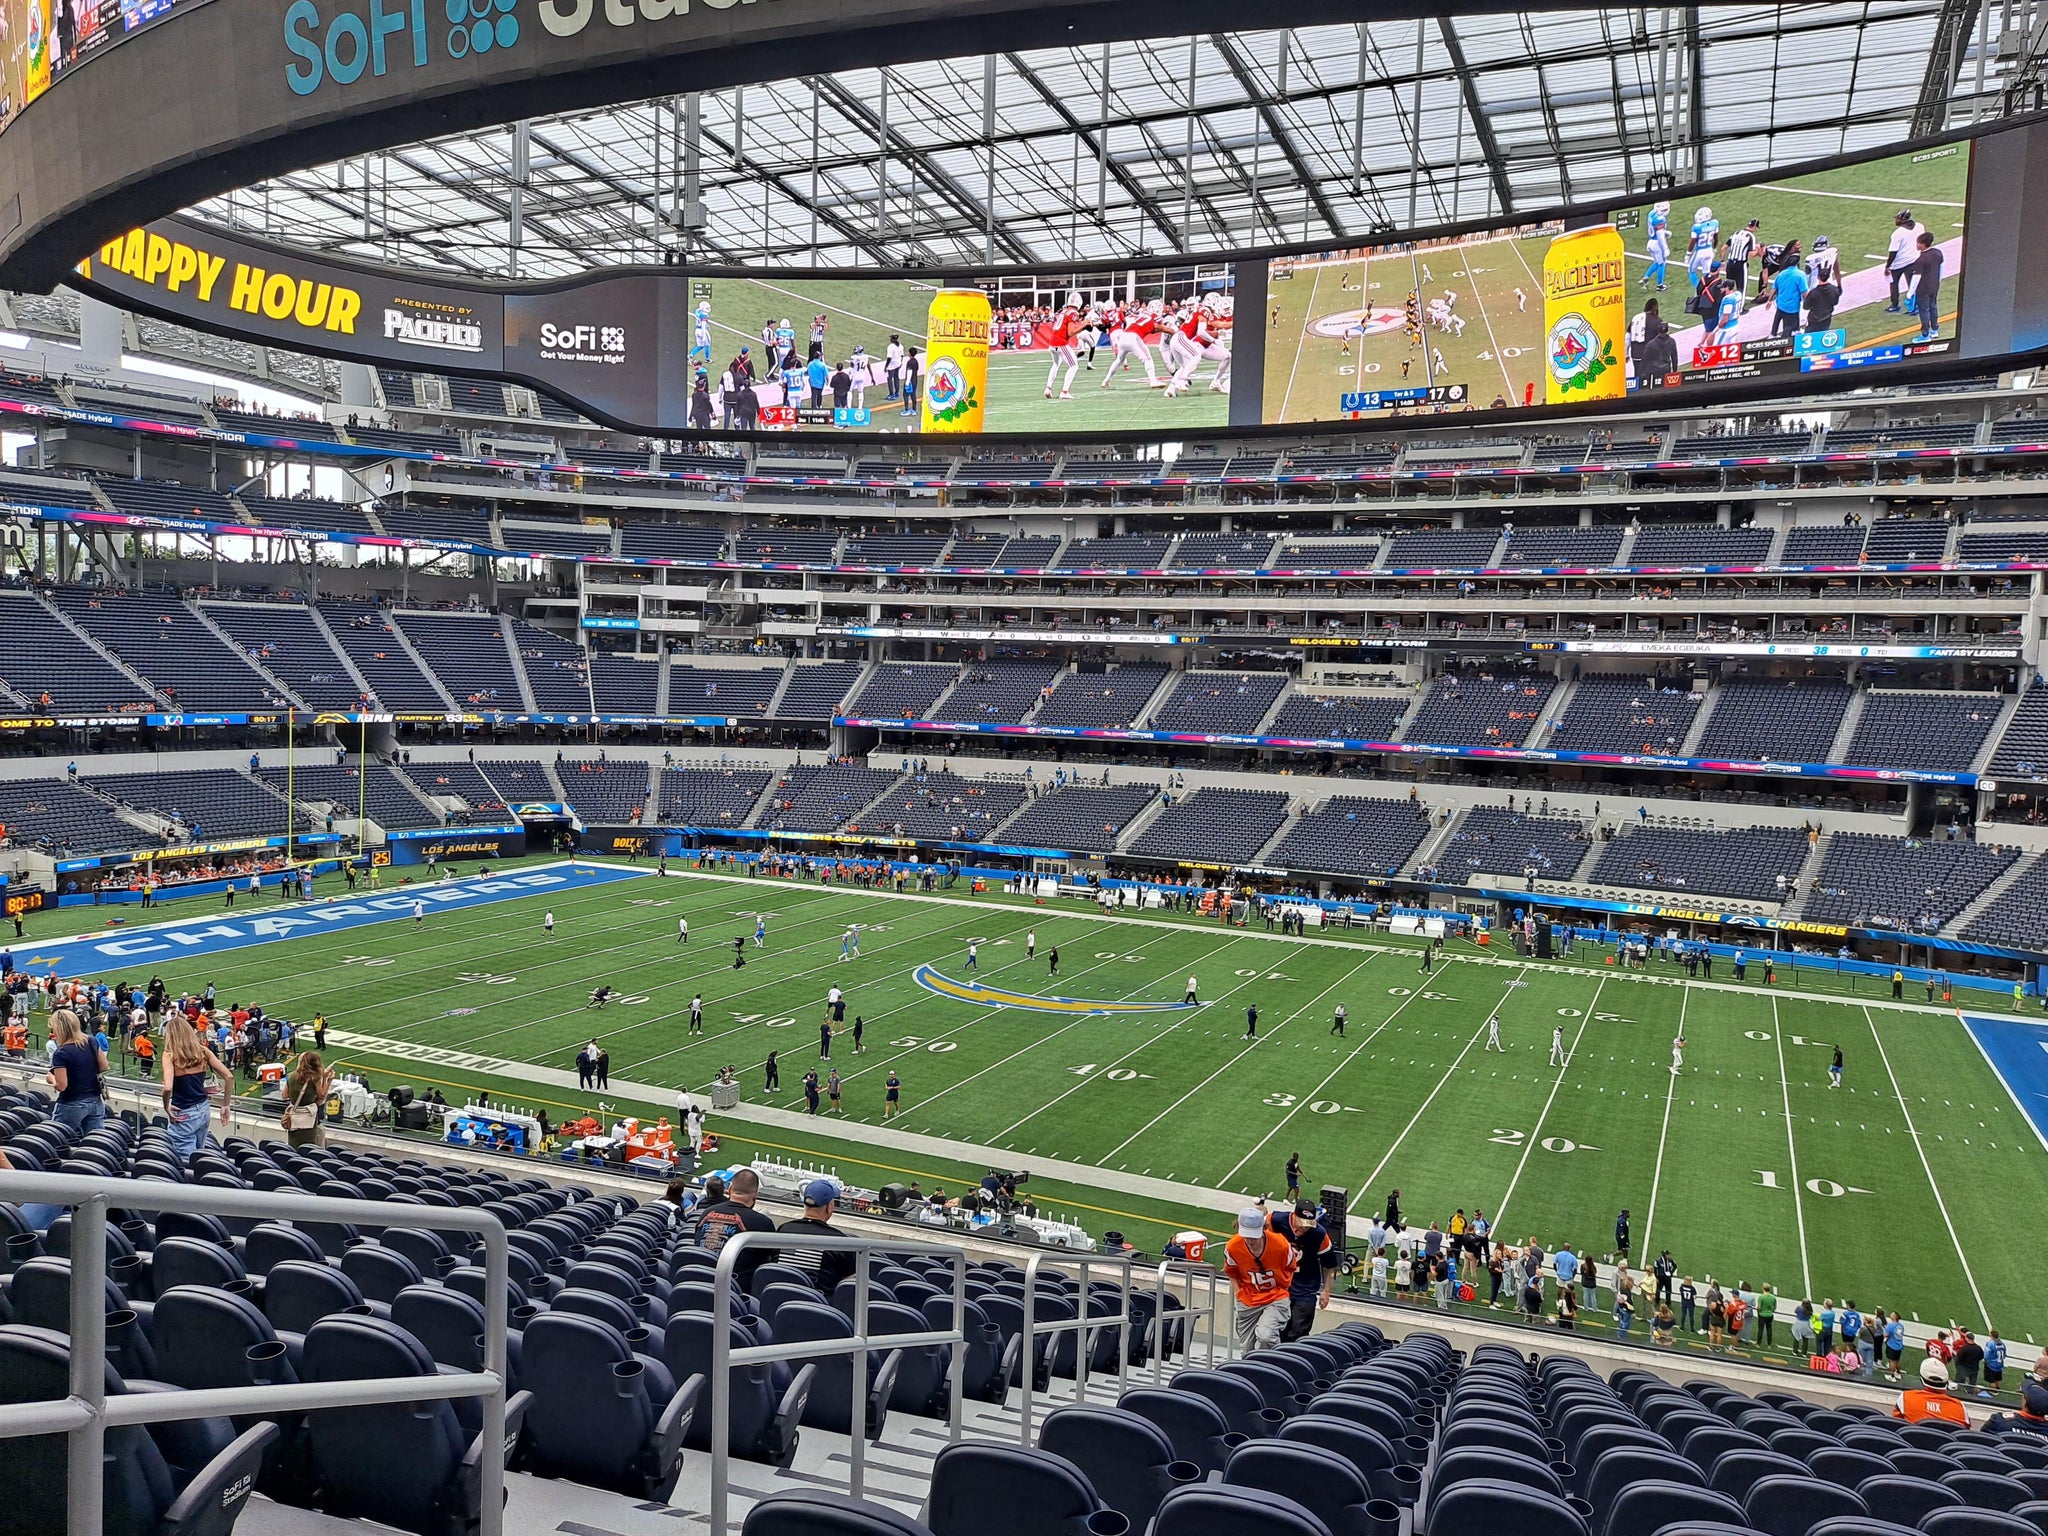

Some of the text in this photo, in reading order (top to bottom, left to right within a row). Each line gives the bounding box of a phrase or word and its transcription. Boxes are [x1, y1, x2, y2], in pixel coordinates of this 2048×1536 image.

[1931, 148, 1957, 159] SPORTS
[100, 228, 361, 334] HAPPY HOUR
[394, 298, 473, 315] PRESENTED BY
[415, 312, 481, 326] CERVEZA
[383, 308, 482, 347] PACIFICO
[540, 322, 596, 350] SoFi
[779, 335, 790, 346] 26
[1719, 345, 1738, 359] 12
[1764, 339, 1789, 347] SPORTS
[1801, 335, 1812, 349] 3
[540, 351, 625, 364] Get Your Money Right
[1840, 350, 1873, 360] WEEKDAYS
[1338, 363, 1381, 376] 50
[790, 375, 801, 387] 10
[1363, 388, 1445, 405] 13 17
[88, 414, 112, 423] Hybrid
[780, 410, 794, 419] 12
[840, 410, 847, 420] 3
[1768, 645, 1775, 653] 6
[1813, 646, 1828, 655] 38
[1861, 647, 1868, 655] 0
[1929, 649, 1974, 657] FANTASY
[89, 718, 140, 726] STORM
[1933, 773, 1955, 781] Hybrid
[613, 838, 637, 848] BOLT
[769, 831, 916, 846] CHARGERS.COM/TICKETS
[132, 839, 268, 861] LOS ANGELES CHARGERS
[422, 842, 500, 855] LOS ANGELES
[374, 852, 390, 865] 25
[1178, 862, 1219, 870] WELCOME
[1254, 868, 1288, 877] STORM
[8, 893, 42, 913] 80:17
[94, 872, 567, 956] CHARGERS
[1628, 903, 1847, 936] LOS ANGELES CHARGERS
[728, 1011, 797, 1028] 40
[889, 1035, 957, 1053] 50
[1744, 1030, 1809, 1046] 10
[329, 1035, 511, 1073] INTERCEPT
[266, 1071, 276, 1081] G
[1066, 1062, 1137, 1082] 40
[1262, 1092, 1341, 1115] 30
[1487, 1128, 1576, 1153] 20
[1752, 1169, 1845, 1198] 10
[1189, 1244, 1201, 1258] G
[1249, 1270, 1276, 1290] 15
[1926, 1401, 1941, 1413] NIX
[223, 1480, 242, 1498] SoFi
[223, 1485, 250, 1507] Stadium
